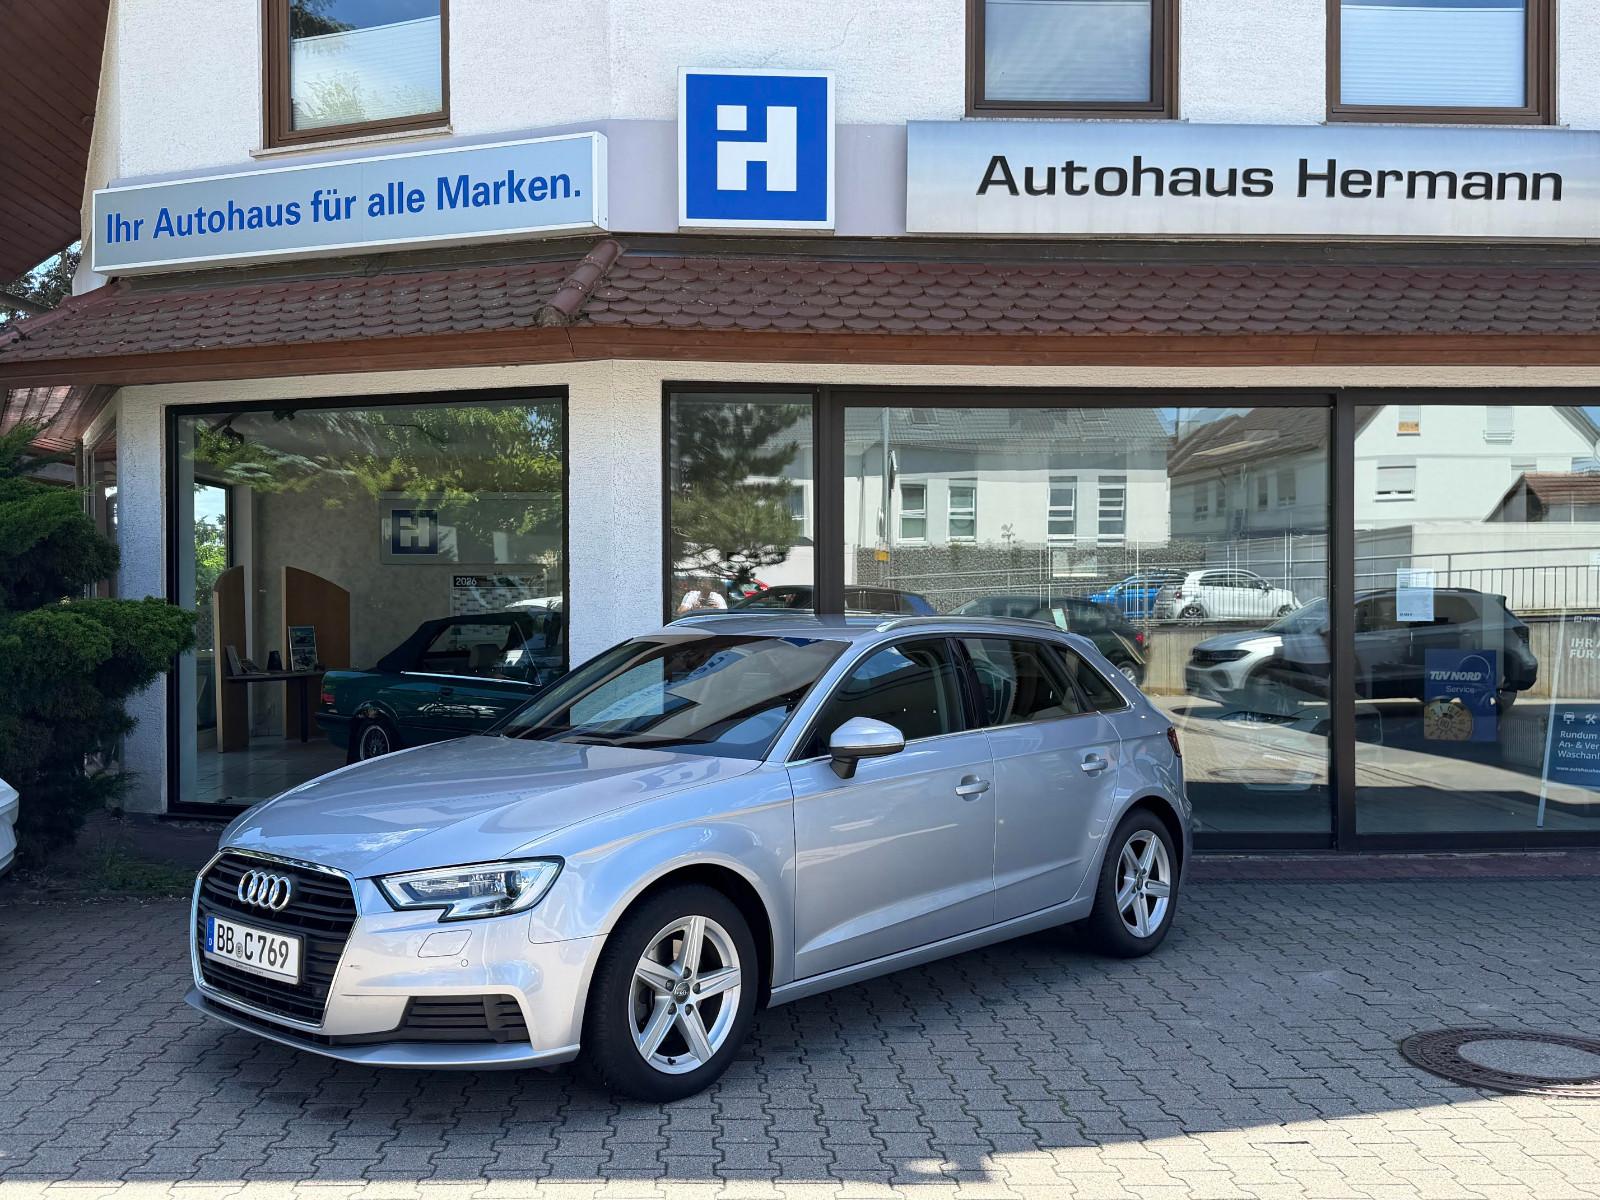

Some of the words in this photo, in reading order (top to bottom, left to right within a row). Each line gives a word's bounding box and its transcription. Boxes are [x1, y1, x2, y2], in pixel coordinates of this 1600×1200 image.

[976, 155, 1274, 198] Autohaus
[1297, 158, 1563, 202] Hermann
[106, 212, 144, 244] Ihr
[152, 200, 301, 239] Autohaus
[310, 188, 357, 223] für
[367, 181, 425, 218] alle
[437, 169, 581, 211] Marken.
[455, 577, 477, 586] 2026
[1571, 638, 1593, 648] IHR
[1450, 671, 1482, 681] NORD
[1446, 685, 1475, 694] Service
[1560, 730, 1598, 740] Rundum
[1558, 740, 1574, 748] An-
[1575, 741, 1582, 749] &
[208, 937, 213, 946] D
[217, 923, 235, 954] BB
[244, 931, 254, 961] C
[257, 934, 289, 969] 769
